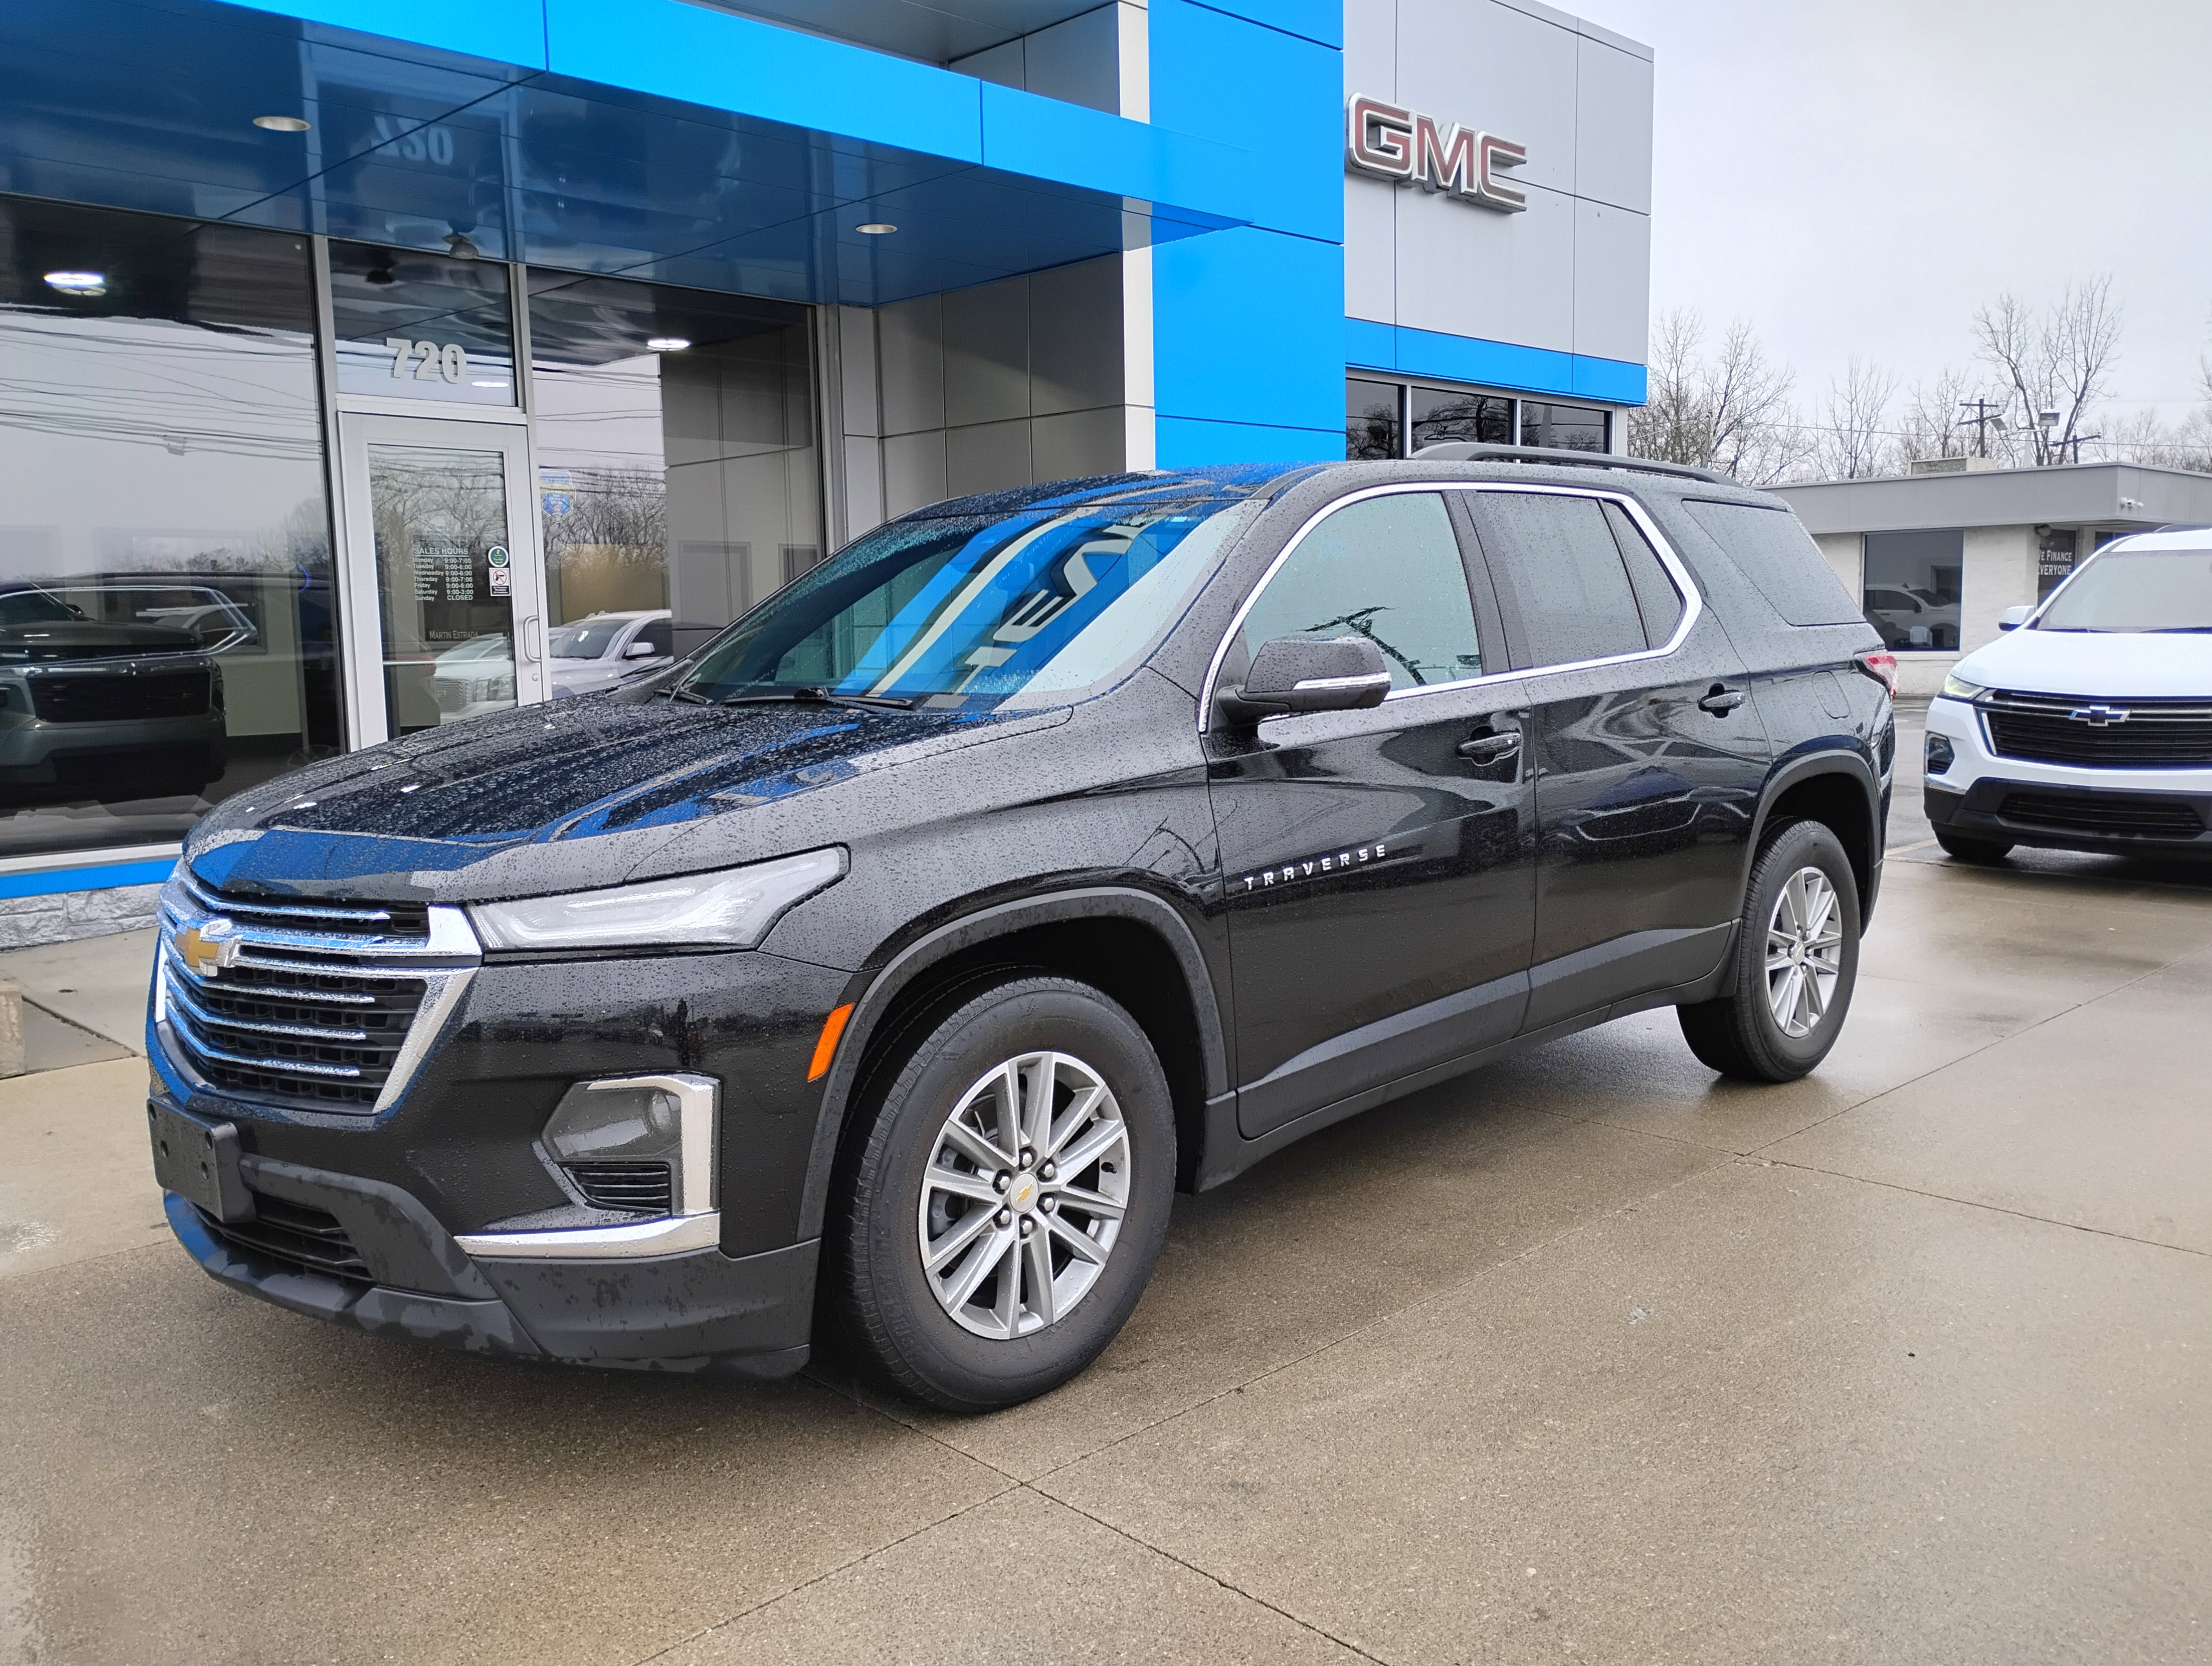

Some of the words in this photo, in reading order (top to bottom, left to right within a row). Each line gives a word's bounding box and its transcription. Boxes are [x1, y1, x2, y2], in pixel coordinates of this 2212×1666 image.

[1347, 92, 1528, 214] GMC
[387, 337, 467, 384] 720
[2047, 550, 2072, 561] FINANCE
[429, 630, 452, 639] MARTIN
[1244, 844, 1385, 890] TRAVERSE
